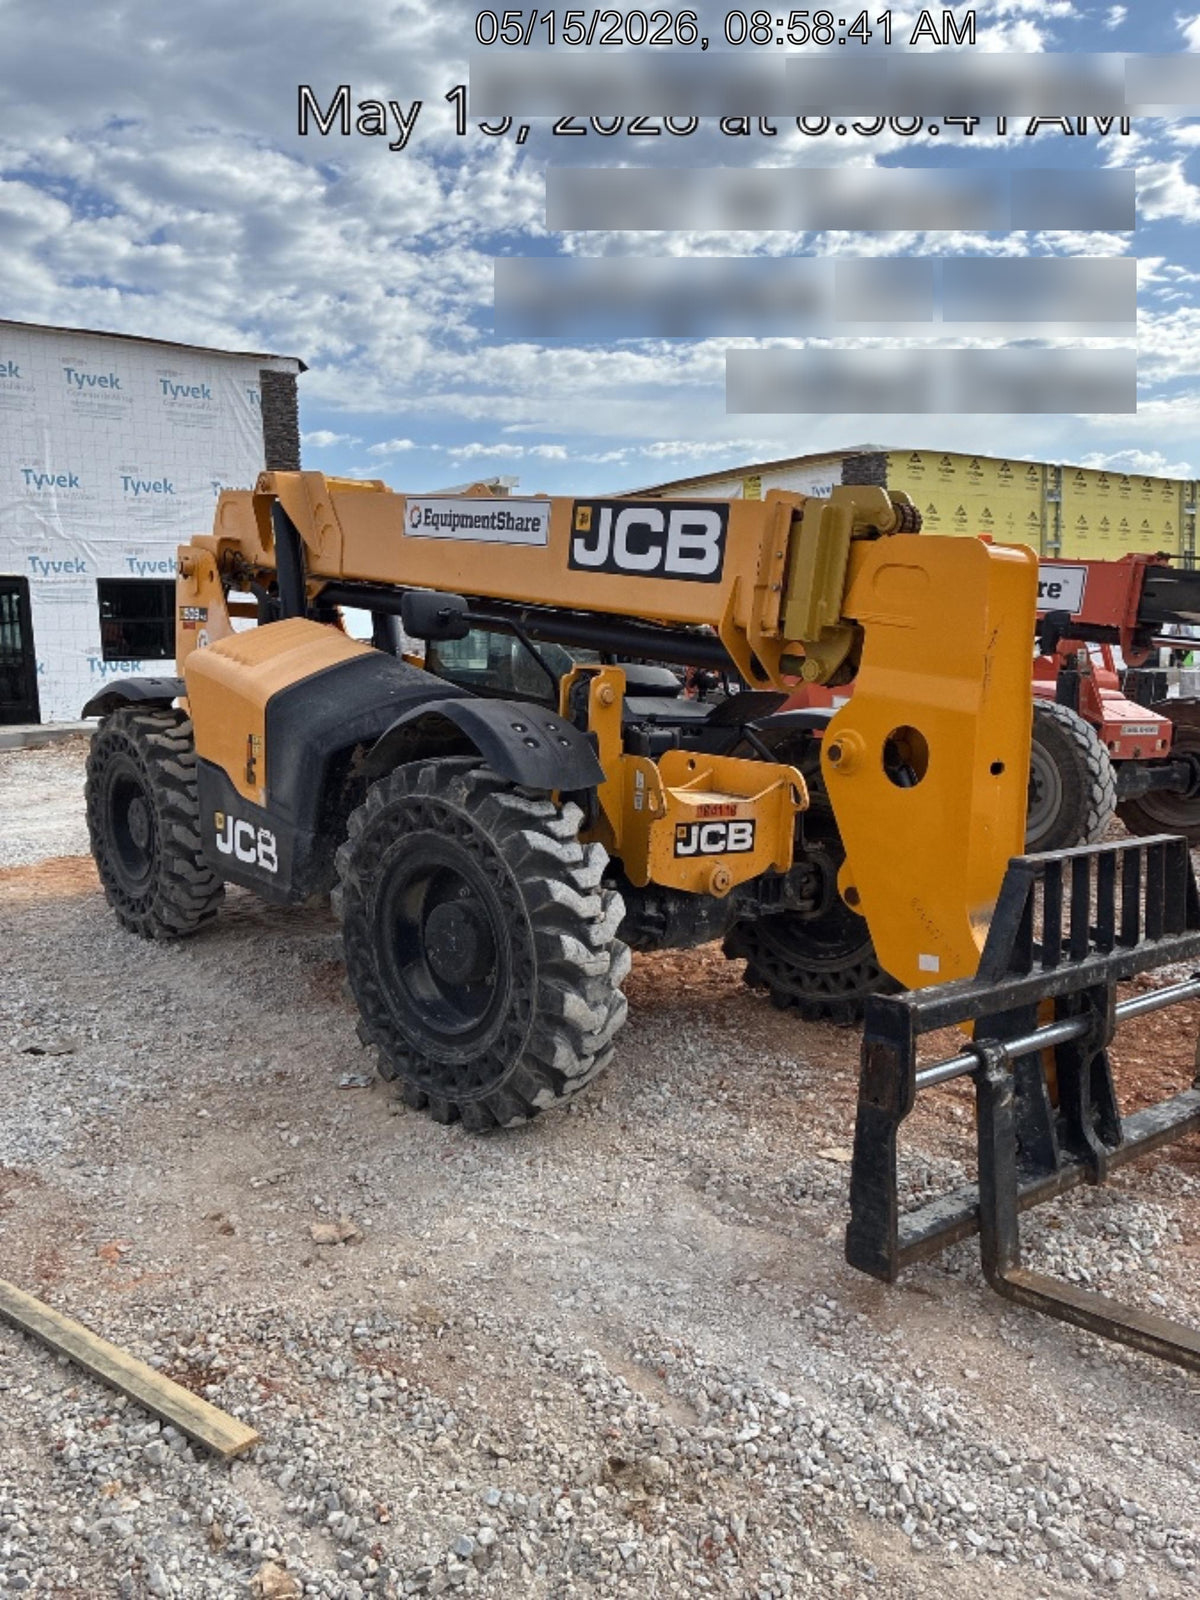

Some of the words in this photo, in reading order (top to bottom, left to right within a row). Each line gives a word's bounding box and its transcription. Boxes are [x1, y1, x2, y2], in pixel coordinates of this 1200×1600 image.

[63, 367, 121, 390] Tyvek
[159, 378, 212, 400] Tyvek
[21, 468, 79, 490] Tyvek
[121, 475, 175, 496] Tyvek
[423, 508, 542, 533] EquipmentShare
[573, 507, 723, 575] JCB
[28, 555, 86, 576] Tyvek
[126, 557, 178, 577] Tyvek
[87, 657, 142, 678] Tyvek
[216, 815, 278, 873] JCB
[676, 822, 753, 855] JCB
